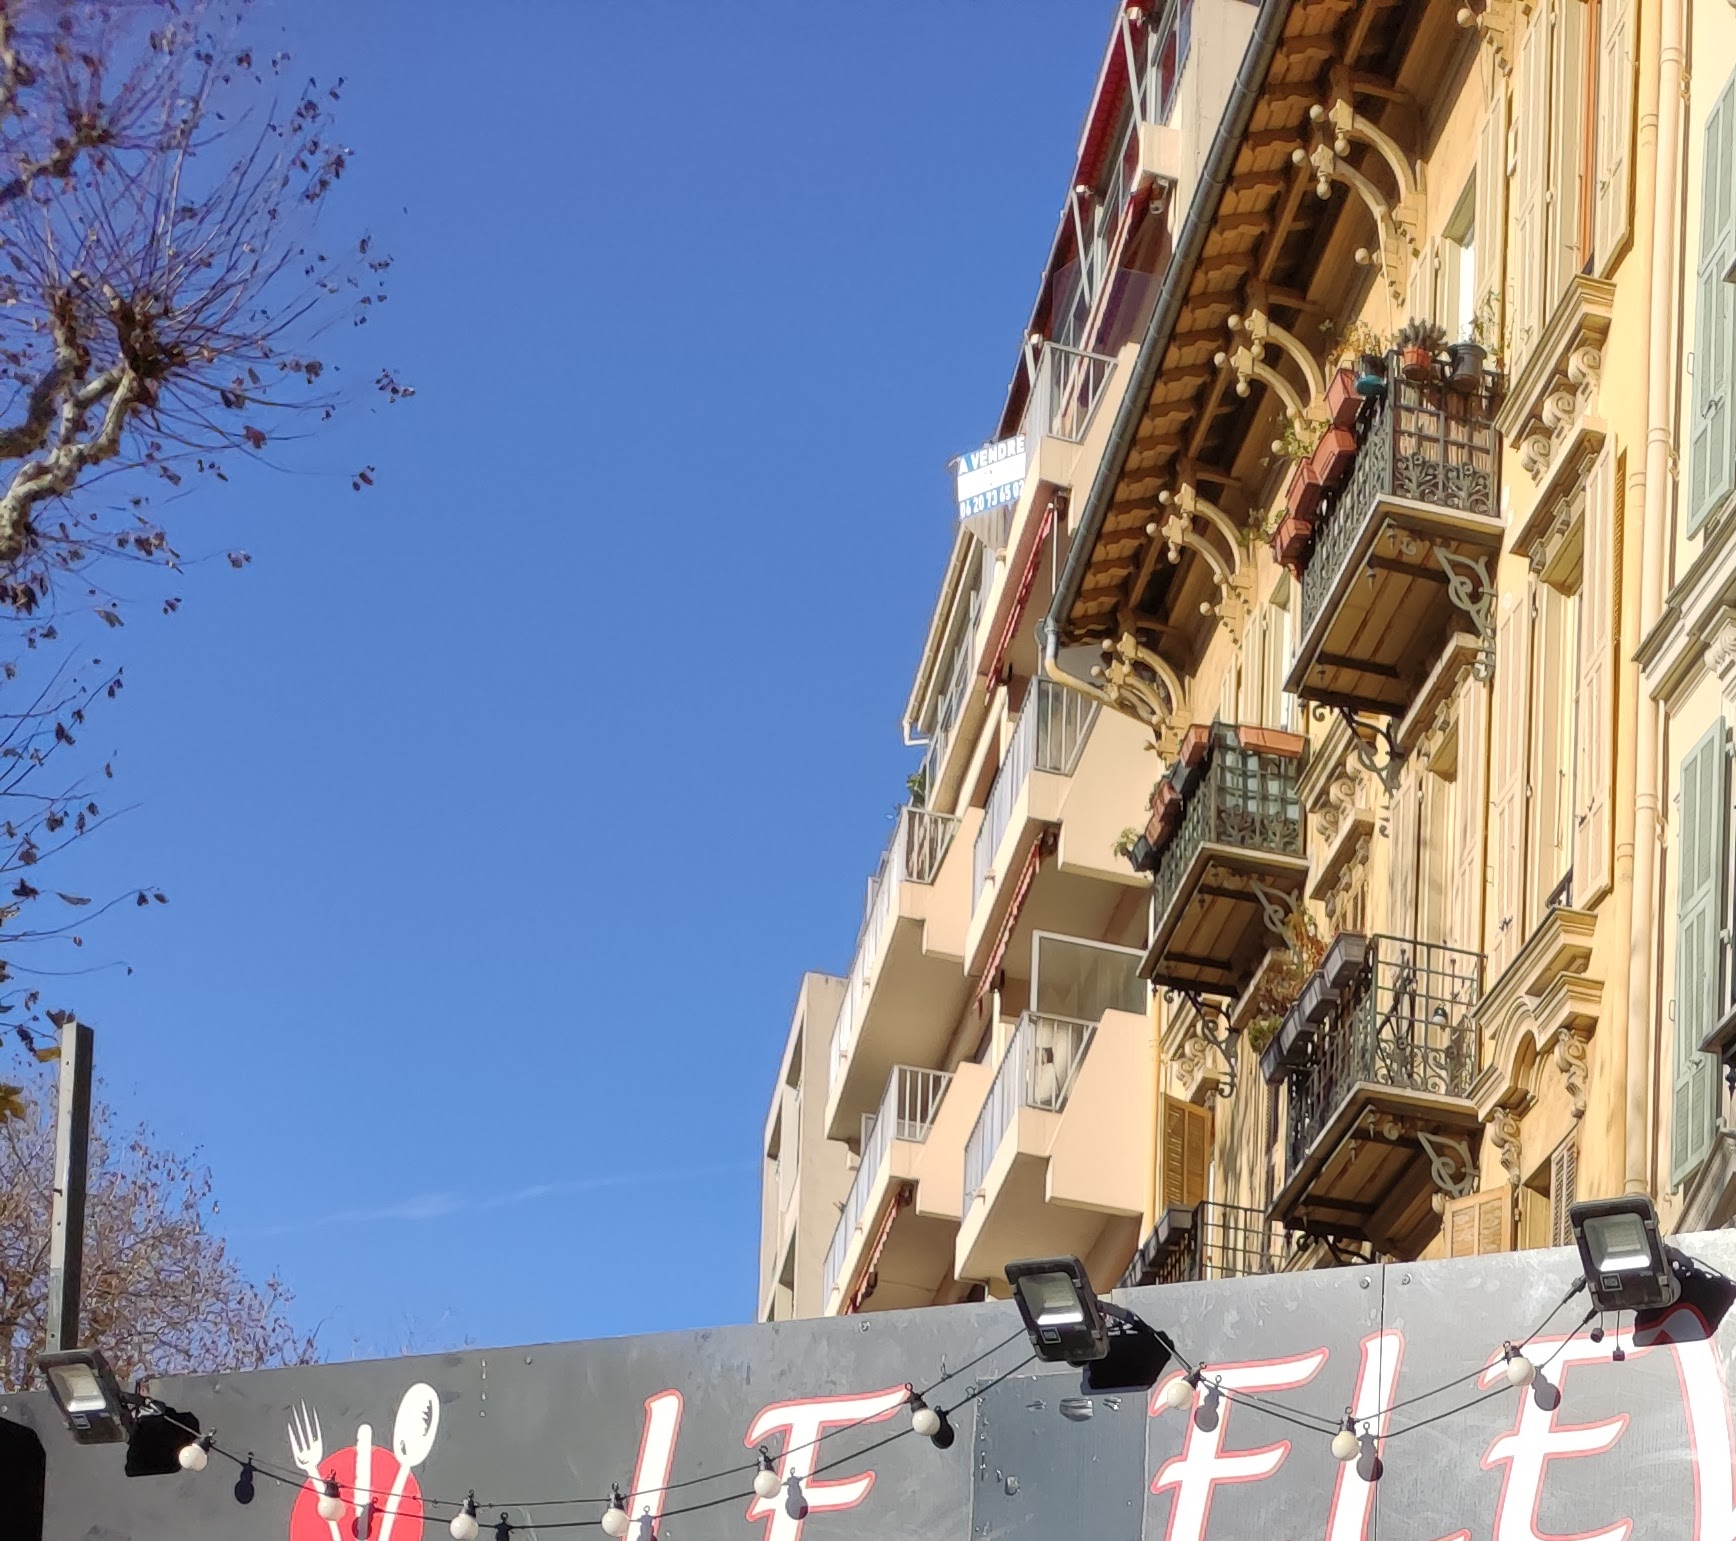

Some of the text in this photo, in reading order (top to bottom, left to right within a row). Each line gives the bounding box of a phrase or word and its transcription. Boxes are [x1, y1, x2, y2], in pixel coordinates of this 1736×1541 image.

[959, 434, 1025, 475] A VENDRE
[959, 500, 972, 519] 06
[973, 494, 985, 513] 20
